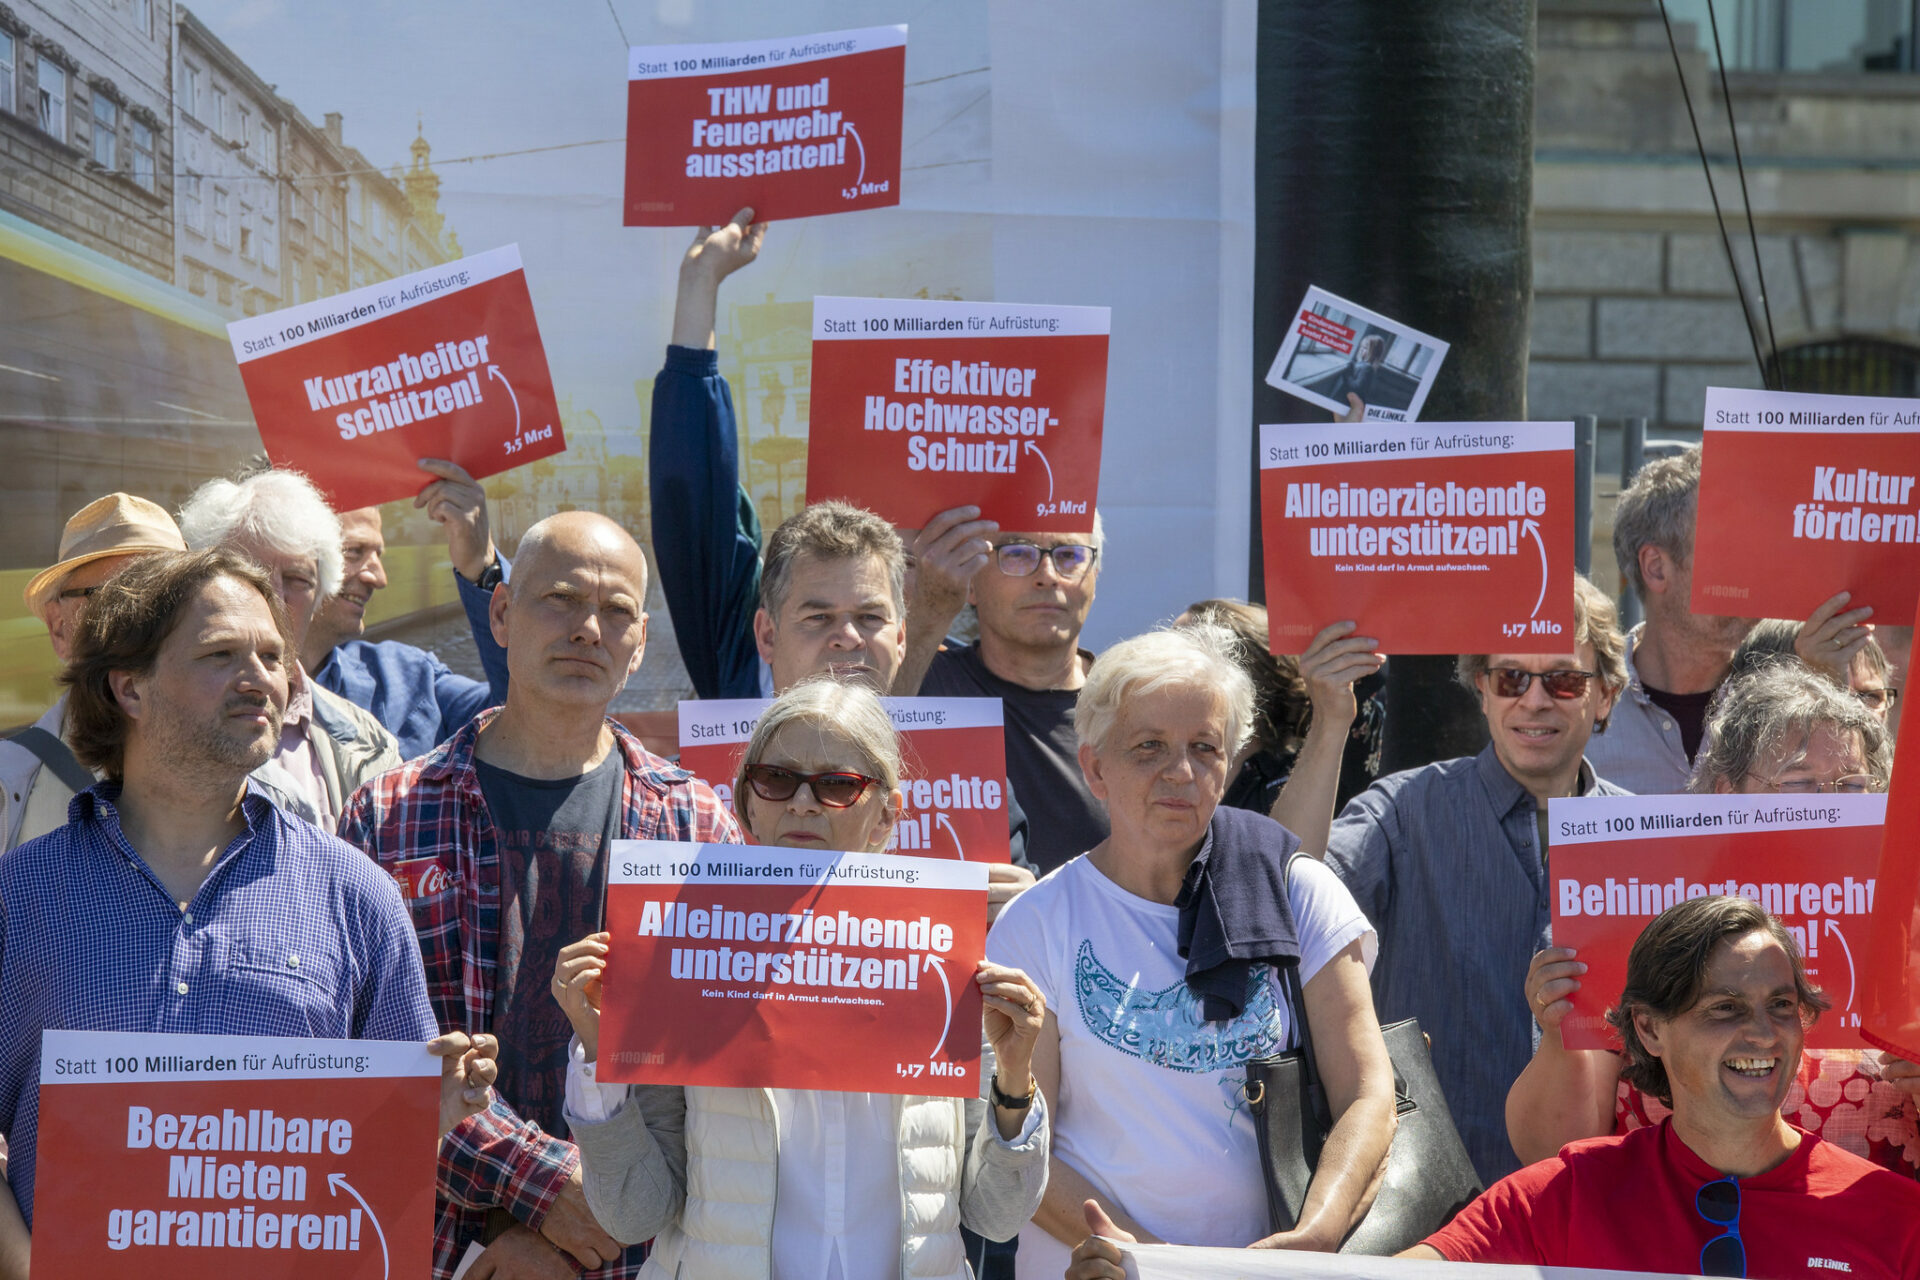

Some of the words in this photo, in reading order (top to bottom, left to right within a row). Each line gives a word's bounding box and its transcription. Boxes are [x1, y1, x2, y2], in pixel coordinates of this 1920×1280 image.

[638, 62, 667, 74] Statt
[673, 59, 697, 71] 100
[701, 53, 765, 69] Milliarden
[769, 49, 785, 62] für
[789, 38, 857, 59] Aufrüstung:
[707, 84, 771, 116] THW
[776, 77, 829, 111] und
[692, 110, 842, 147] Feuerwehr
[685, 136, 846, 178] ausstatten!
[842, 187, 858, 199] 1,3
[861, 180, 889, 195] Mrd
[243, 334, 275, 354] Statt
[278, 325, 304, 344] 100
[308, 303, 376, 334] Milliarden
[378, 295, 396, 310] für
[400, 271, 470, 304] Aufrüstung:
[824, 319, 856, 333] Statt
[863, 319, 889, 332] 100
[893, 318, 963, 331] Milliarden
[967, 317, 984, 330] für
[989, 316, 1059, 331] Aufrüstung:
[304, 334, 490, 411] Kurzarbeiter
[894, 358, 1036, 397] Effektiver
[336, 371, 483, 440] schützen!
[864, 396, 1058, 436] Hochwasser-
[1367, 408, 1381, 418] DIE
[1716, 410, 1750, 424] Statt
[1757, 411, 1784, 425] 100
[1789, 412, 1865, 426] Milliarden
[1870, 412, 1889, 426] für
[504, 437, 522, 455] 3,5
[524, 424, 553, 446] Mrd
[908, 435, 1018, 473] Schutz!
[1270, 447, 1299, 461] Statt
[1304, 444, 1329, 458] 100
[1333, 440, 1406, 456] Milliarden
[1410, 437, 1430, 451] für
[1434, 433, 1514, 450] Aufrüstung:
[1284, 481, 1546, 518] Alleinerziehende
[1813, 466, 1915, 505] Kultur
[1037, 504, 1056, 516] 9,2
[1059, 501, 1086, 515] Mrd
[1310, 520, 1518, 557] unterstützen!
[1335, 564, 1354, 572] Kein
[1355, 563, 1376, 572] Kind
[1377, 563, 1395, 572] darf
[1397, 563, 1406, 571] in
[1406, 563, 1434, 572] Armut
[1435, 563, 1490, 572] aufwachsen.
[1502, 623, 1526, 638] 1,17
[1531, 620, 1562, 635] Mio
[691, 724, 726, 738] Statt
[1561, 821, 1597, 837] Statt
[1604, 818, 1634, 833] 100
[1640, 813, 1723, 831] Milliarden
[1727, 810, 1750, 825] für
[1754, 806, 1841, 824] Aufrüstung:
[623, 863, 662, 877] Statt
[669, 863, 701, 877] 100
[707, 863, 794, 877] Milliarden
[799, 863, 821, 878] für
[827, 864, 920, 884] Aufrüstung:
[638, 901, 953, 953] Alleinerziehende
[671, 947, 920, 990] unterstützen!
[702, 988, 725, 998] Kein
[727, 990, 750, 999] Kind
[752, 990, 774, 1000] darf
[775, 992, 785, 1001] in
[787, 993, 820, 1003] Armut
[821, 995, 885, 1006] aufwachsen.
[55, 1057, 96, 1075] Statt
[104, 1056, 139, 1074] 100
[145, 1055, 237, 1073] Milliarden
[242, 1054, 267, 1072] für
[271, 1052, 369, 1073] Aufrüstung:
[610, 1050, 665, 1065] #100Mrd
[896, 1063, 924, 1078] 1,17
[929, 1061, 966, 1078] Mio
[127, 1106, 353, 1155] Bezahlbare
[168, 1155, 307, 1201] Mieten
[107, 1205, 363, 1251] garantieren!
[1808, 1257, 1823, 1268] DIE
